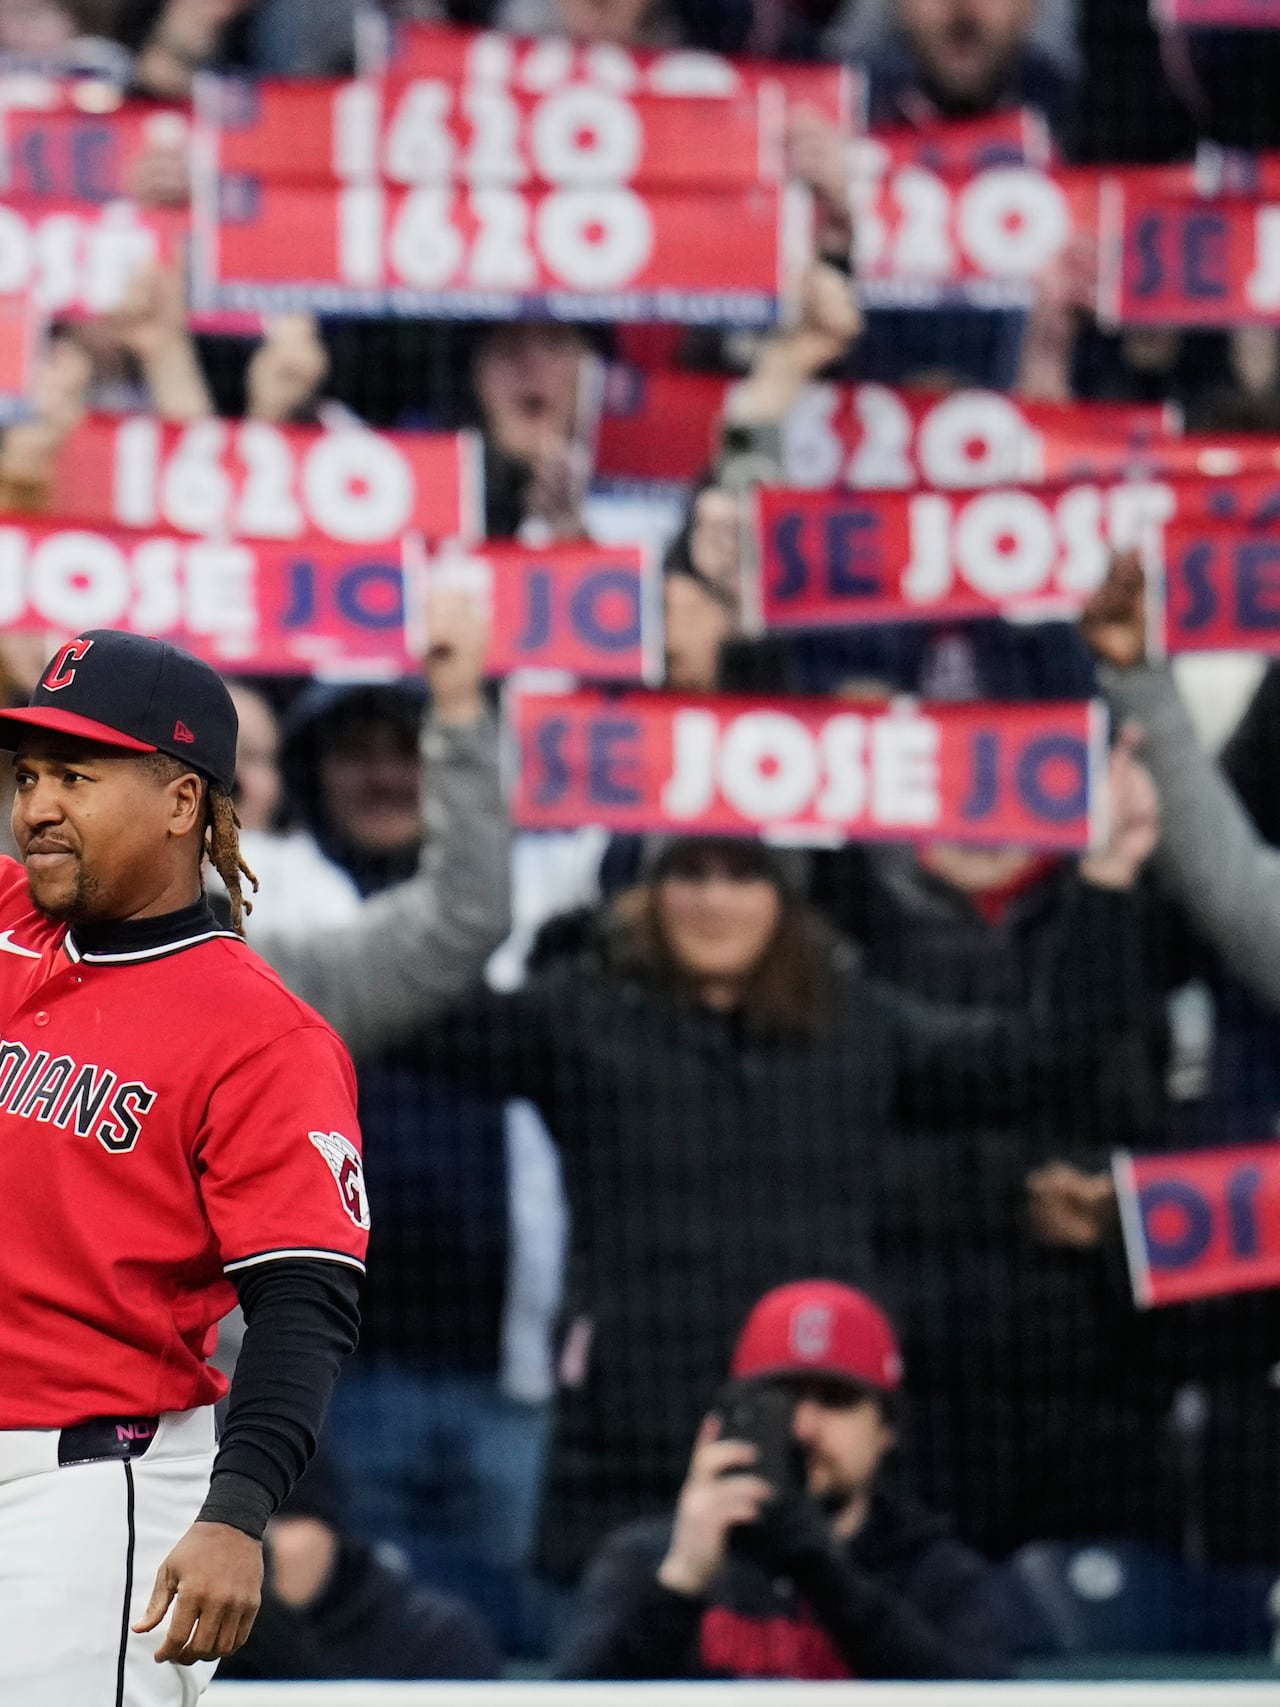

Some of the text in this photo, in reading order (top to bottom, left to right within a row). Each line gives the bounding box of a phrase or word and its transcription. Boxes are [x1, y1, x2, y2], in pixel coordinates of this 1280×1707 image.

[333, 82, 643, 187] 1620
[337, 183, 655, 289] 1620
[112, 415, 417, 545] 1620
[281, 562, 407, 630] JO
[520, 567, 642, 653] JO
[42, 638, 95, 692] C
[960, 728, 1090, 823] JO
